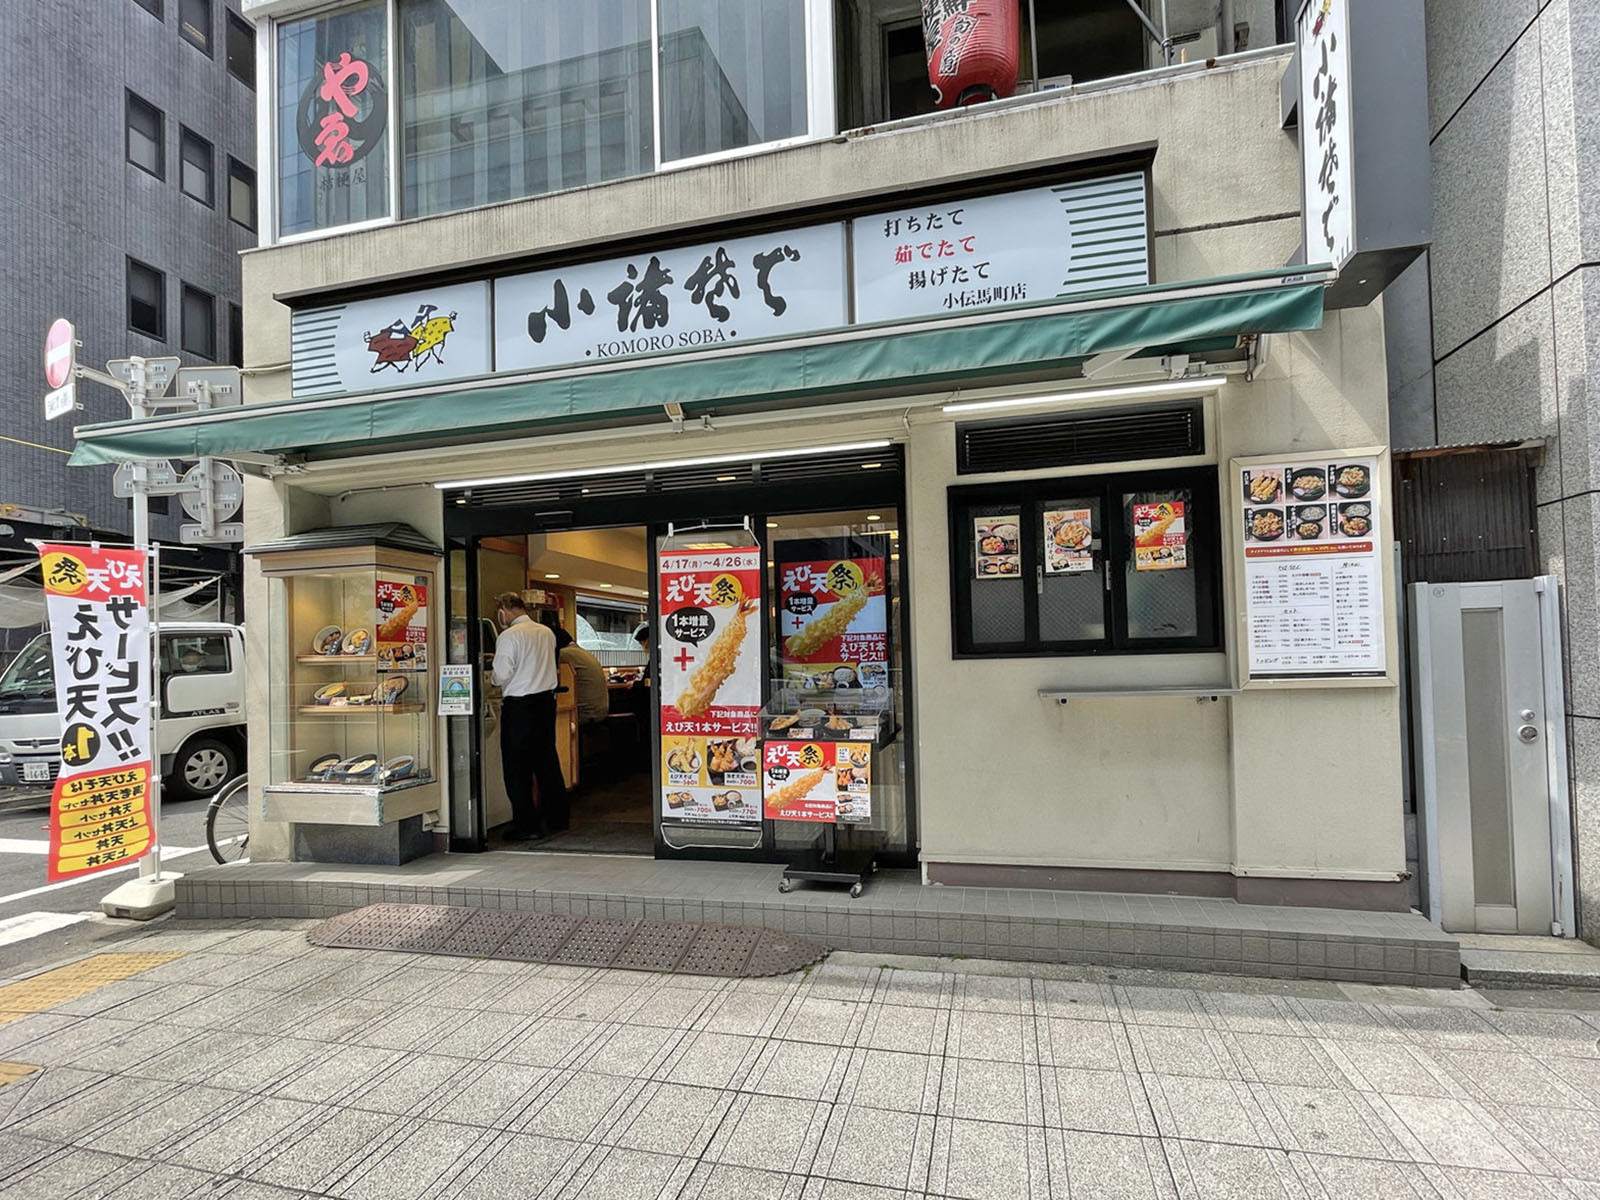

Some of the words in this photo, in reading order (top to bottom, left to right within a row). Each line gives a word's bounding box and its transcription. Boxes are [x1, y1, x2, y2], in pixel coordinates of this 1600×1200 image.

[884, 209, 964, 237] 打ちたて
[894, 236, 976, 264] 茹でたて
[909, 262, 990, 290] 揚げたて
[943, 283, 1026, 309] 小伝馬町店
[597, 333, 674, 358] KOMORO
[679, 327, 726, 347] SOBA
[671, 614, 709, 627] 1本増量
[675, 628, 707, 638] サービス
[841, 642, 886, 652] えび天1本
[192, 708, 221, 717] ATLAS
